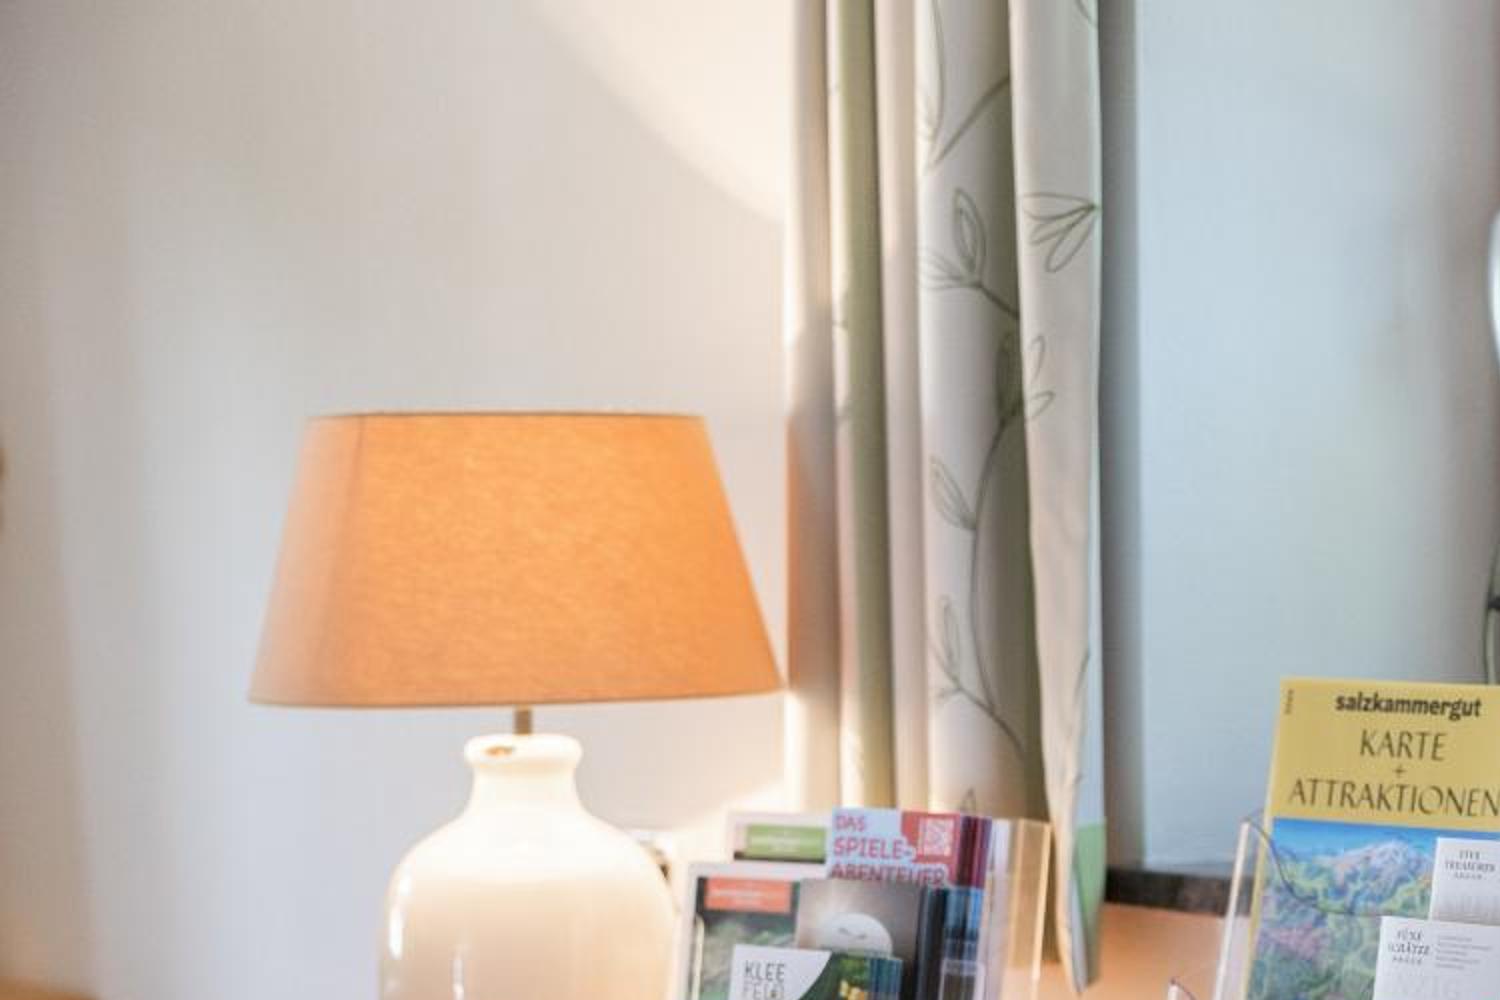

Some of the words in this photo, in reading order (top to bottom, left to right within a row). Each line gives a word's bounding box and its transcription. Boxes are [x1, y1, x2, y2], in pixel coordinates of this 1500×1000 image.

[1335, 691, 1482, 721] salzkammergut
[1359, 729, 1447, 761] KARTE
[835, 814, 866, 832] DAS
[833, 836, 913, 861] SPIELE-
[744, 960, 786, 983] KLEE
